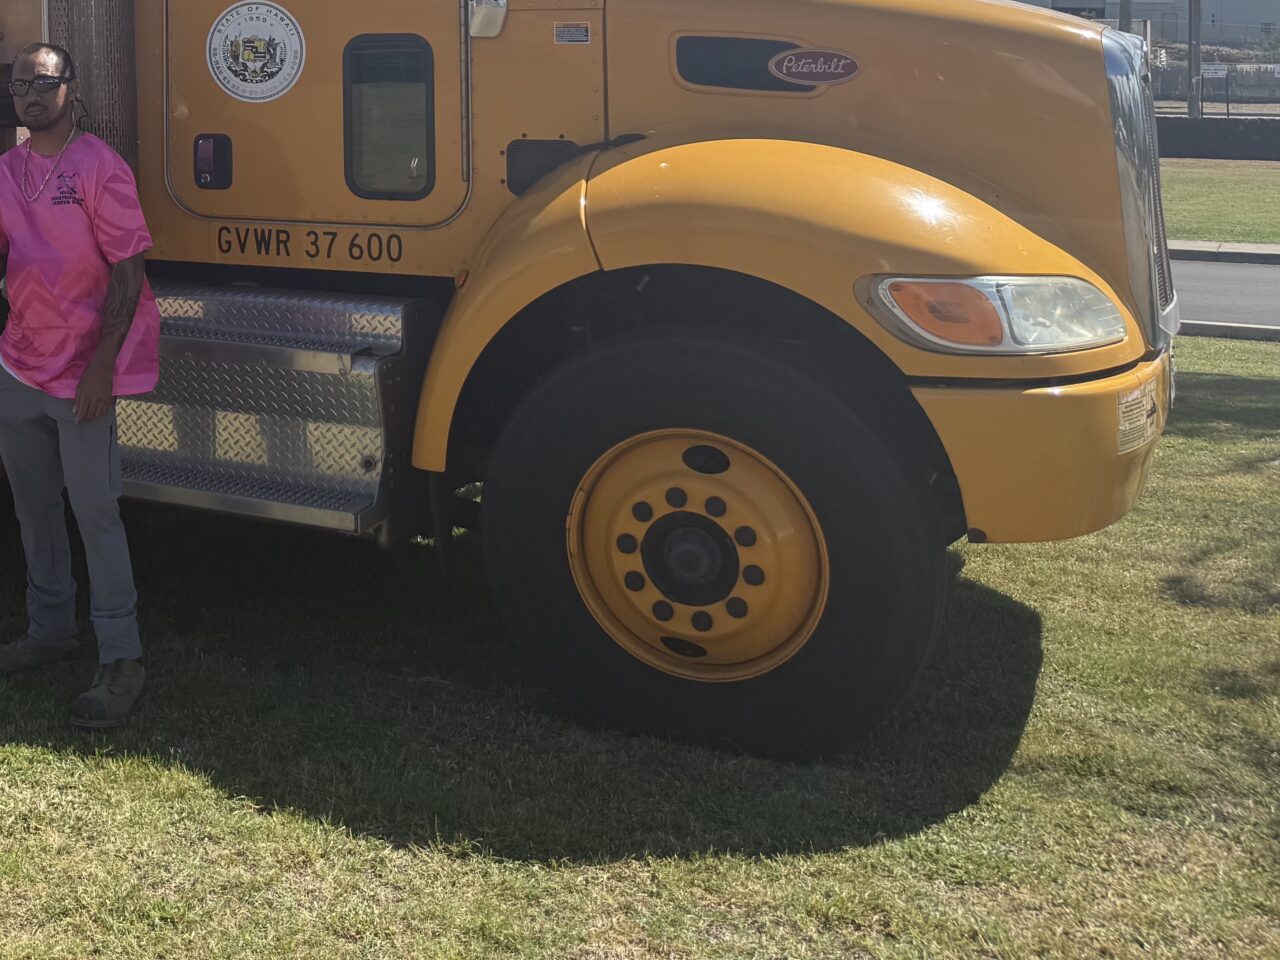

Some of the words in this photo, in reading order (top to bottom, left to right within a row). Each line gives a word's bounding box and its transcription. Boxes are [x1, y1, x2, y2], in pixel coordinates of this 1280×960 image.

[217, 10, 241, 33] STATE
[266, 9, 296, 36] HAWAII
[783, 56, 851, 73] Peterbilt
[217, 226, 291, 257] GVWR
[305, 230, 338, 259] 37
[348, 232, 403, 263] 600
